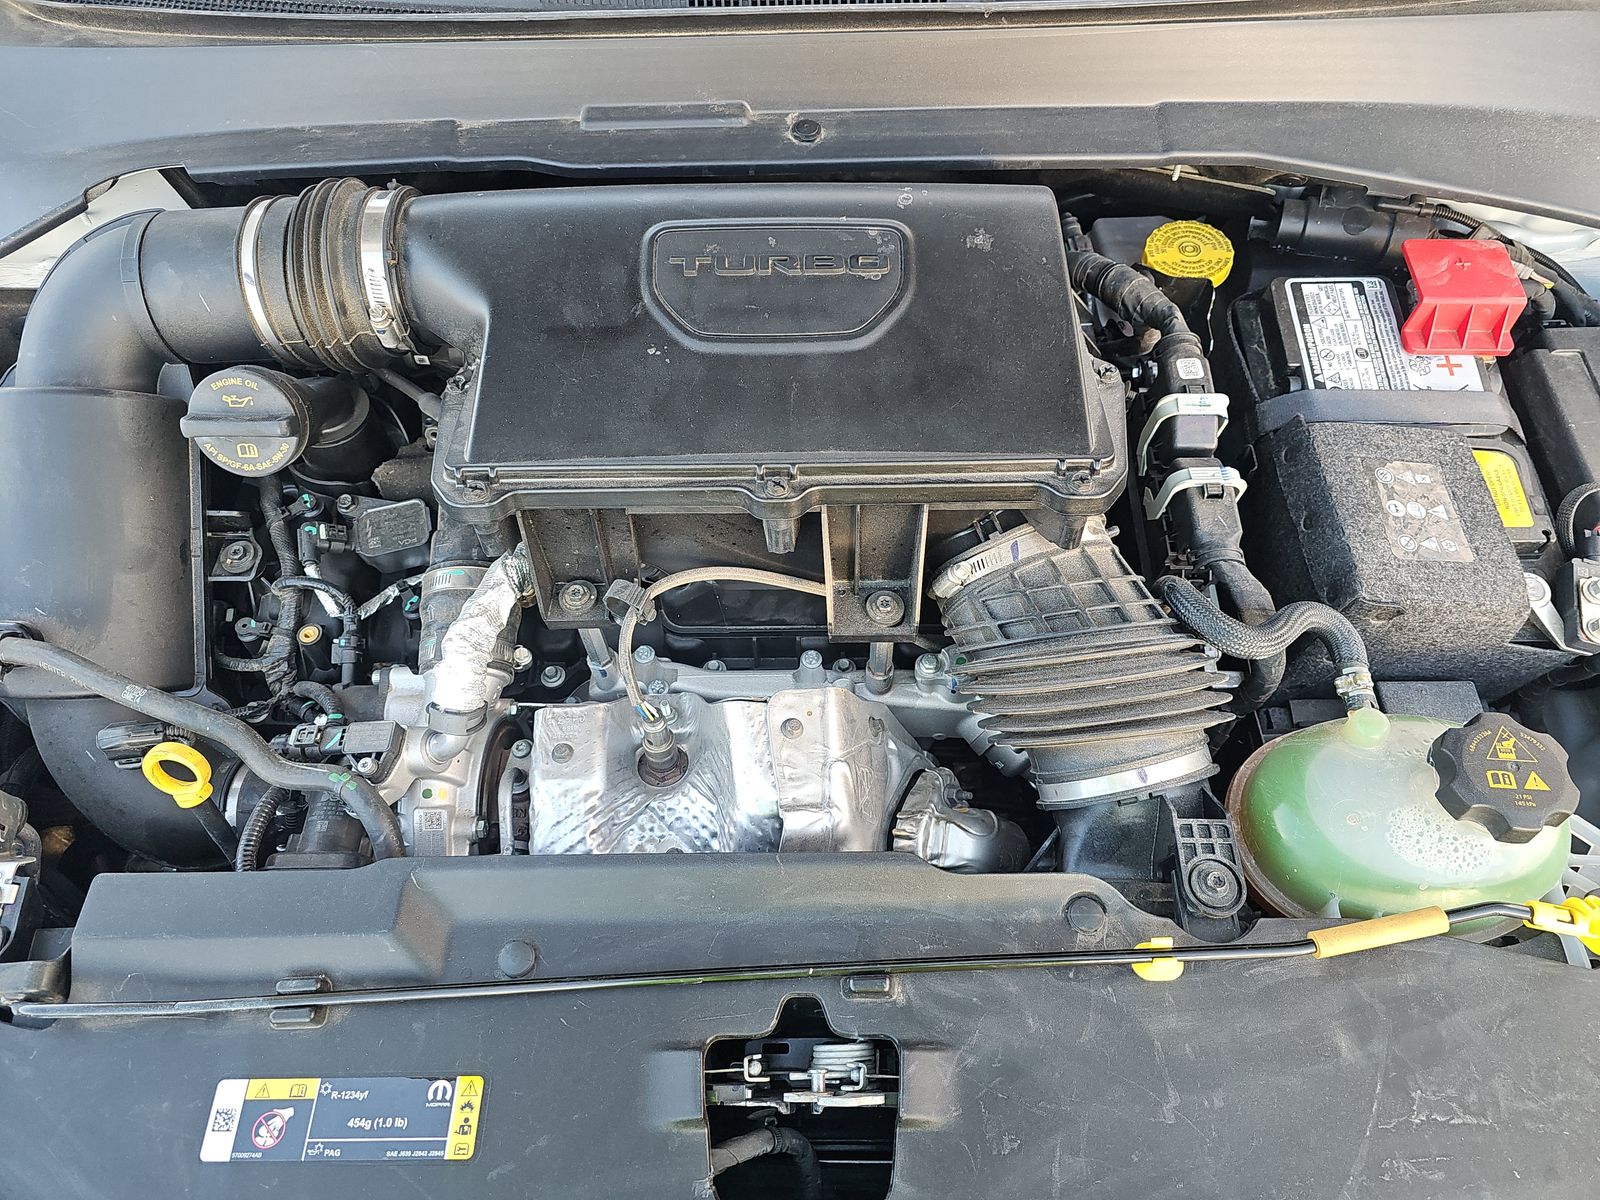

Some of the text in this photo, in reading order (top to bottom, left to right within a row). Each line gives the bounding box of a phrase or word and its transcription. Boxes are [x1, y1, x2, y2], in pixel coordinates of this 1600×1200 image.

[669, 254, 890, 277] TURBO
[1303, 323, 1322, 374] DANGER/POISON
[210, 377, 259, 391] ENGINE OIL
[203, 442, 290, 471] API SP/GF-6A-SAE-5W-30
[331, 1090, 369, 1101] R-1234yf
[347, 1117, 408, 1131] 454g (1.0 lb)
[324, 1149, 341, 1157] PAG
